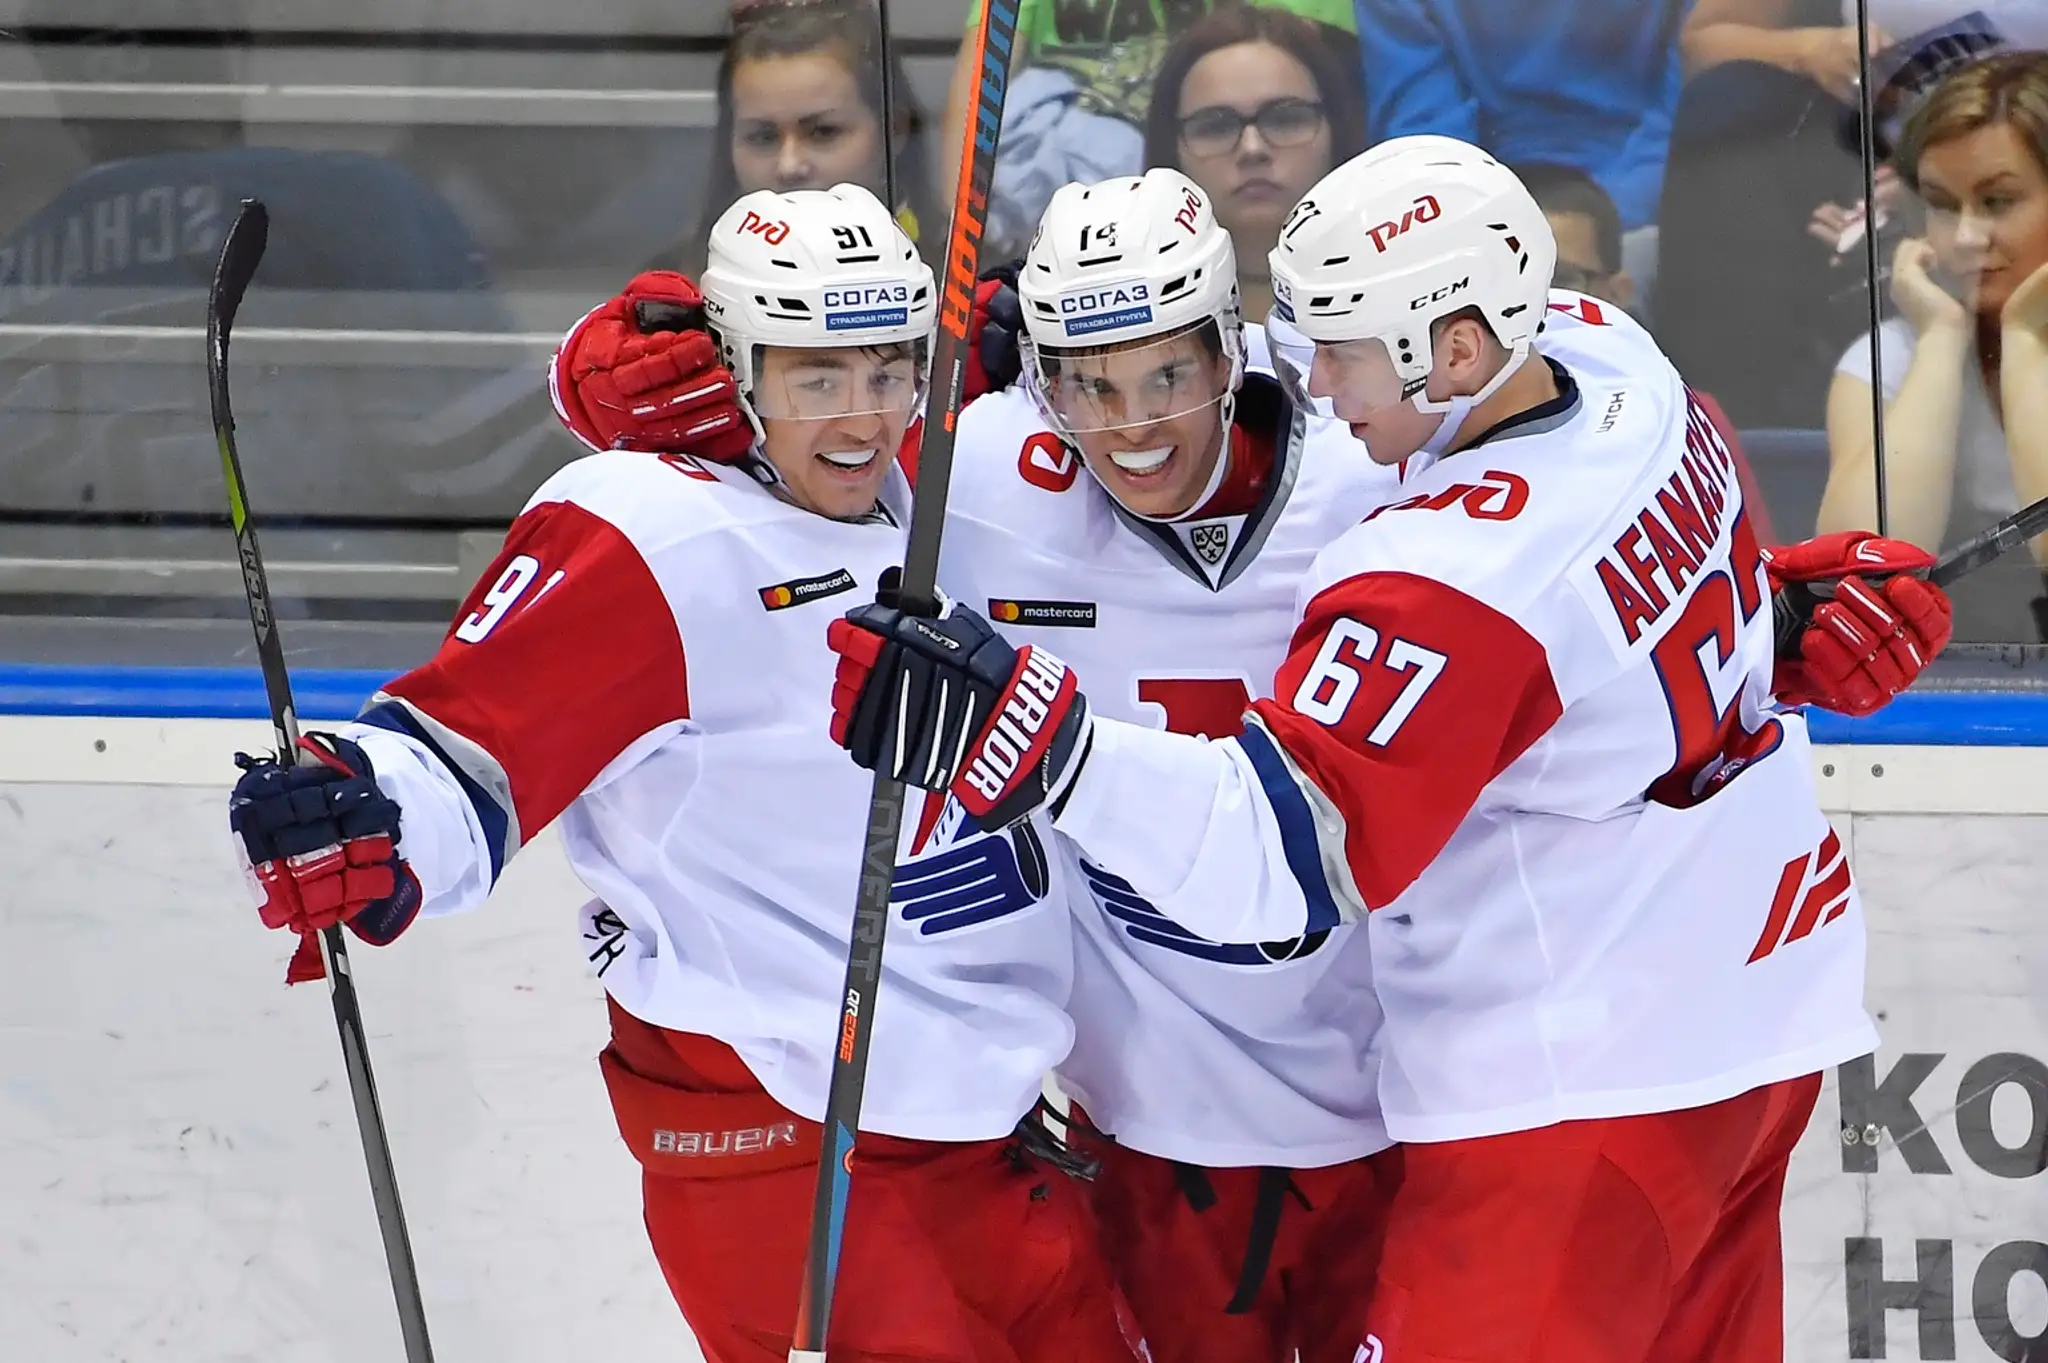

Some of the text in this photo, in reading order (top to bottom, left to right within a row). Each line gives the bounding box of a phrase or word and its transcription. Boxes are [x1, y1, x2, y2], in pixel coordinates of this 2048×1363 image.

[824, 286, 908, 308] СОГАЗ
[1060, 284, 1149, 314] СОГАЗ
[1409, 276, 1469, 311] CCM
[242, 548, 268, 629] CCM
[794, 572, 852, 597] mastercard
[1023, 605, 1094, 620] mastercard
[1292, 616, 1449, 748] 67
[848, 780, 904, 983] OVERT
